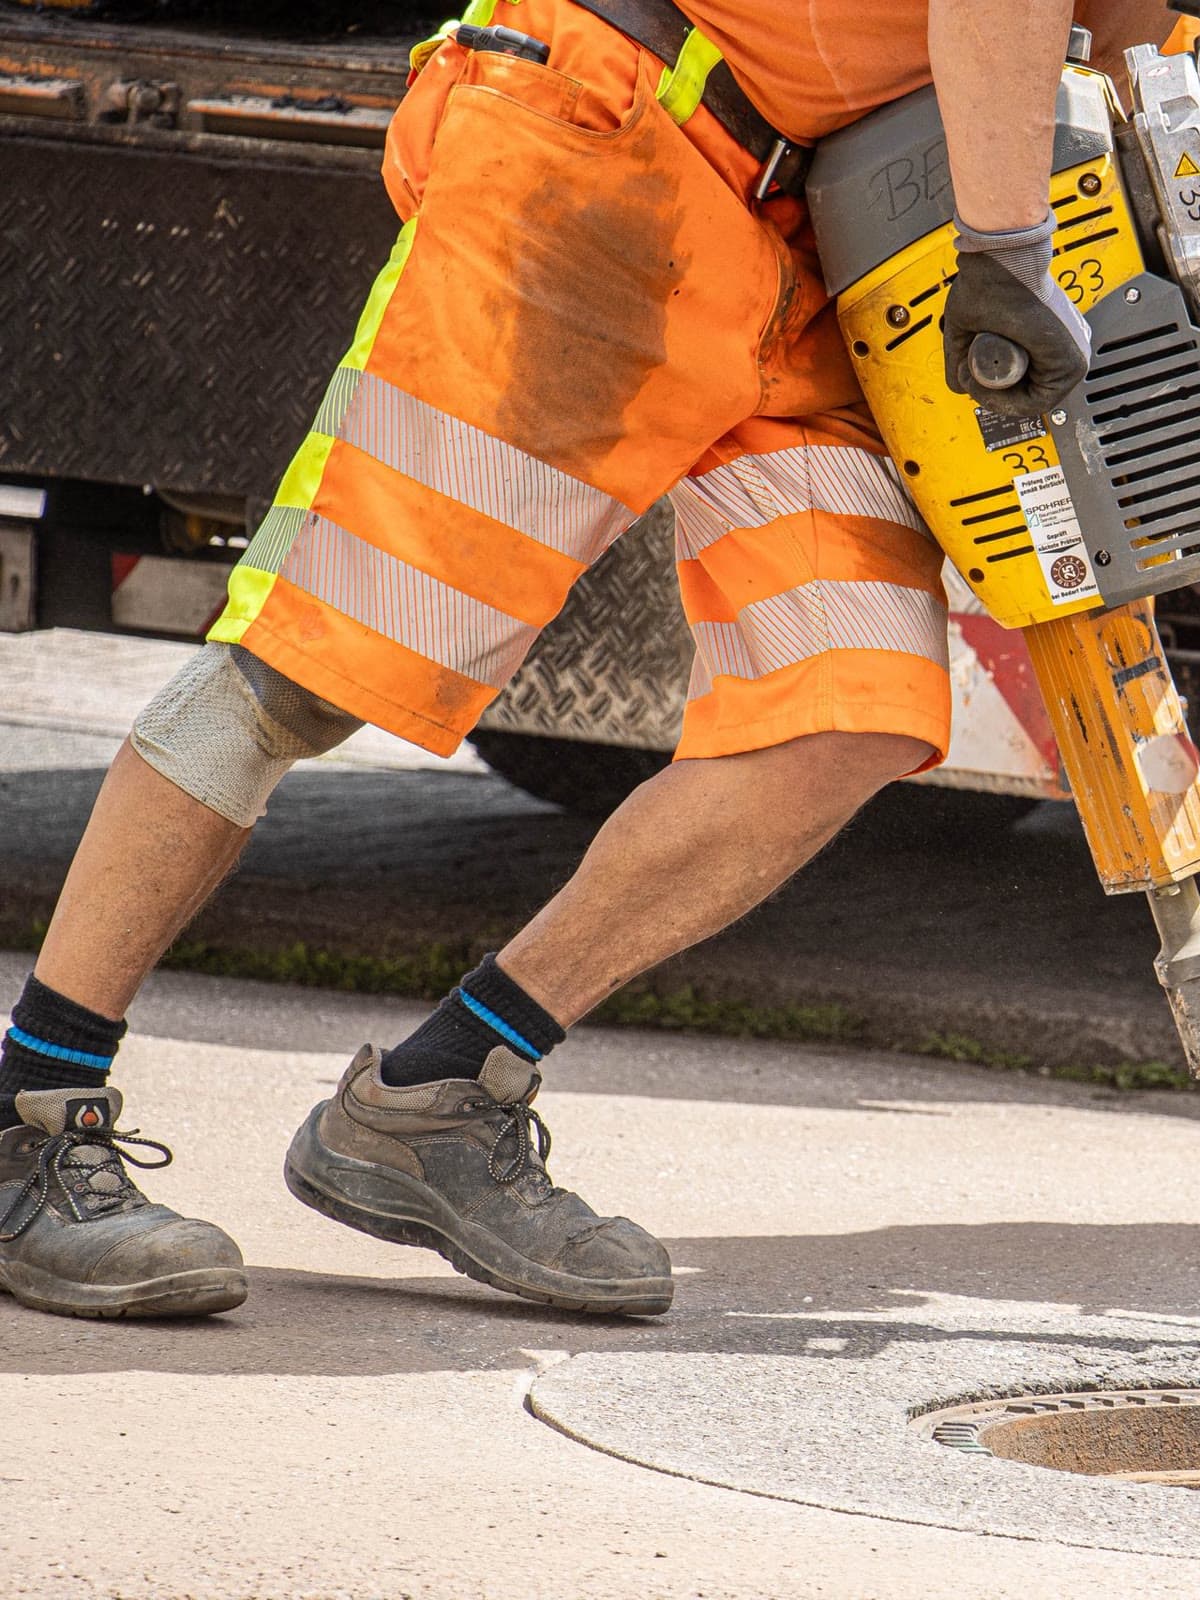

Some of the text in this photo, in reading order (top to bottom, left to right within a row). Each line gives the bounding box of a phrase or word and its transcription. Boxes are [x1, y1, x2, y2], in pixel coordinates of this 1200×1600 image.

[1058, 258, 1104, 305] 33
[1003, 445, 1051, 474] 33
[1021, 476, 1044, 487] Prüfung
[1046, 530, 1067, 540] Geprüft
[1060, 536, 1082, 547] Prüfung
[1062, 565, 1076, 579] 25
